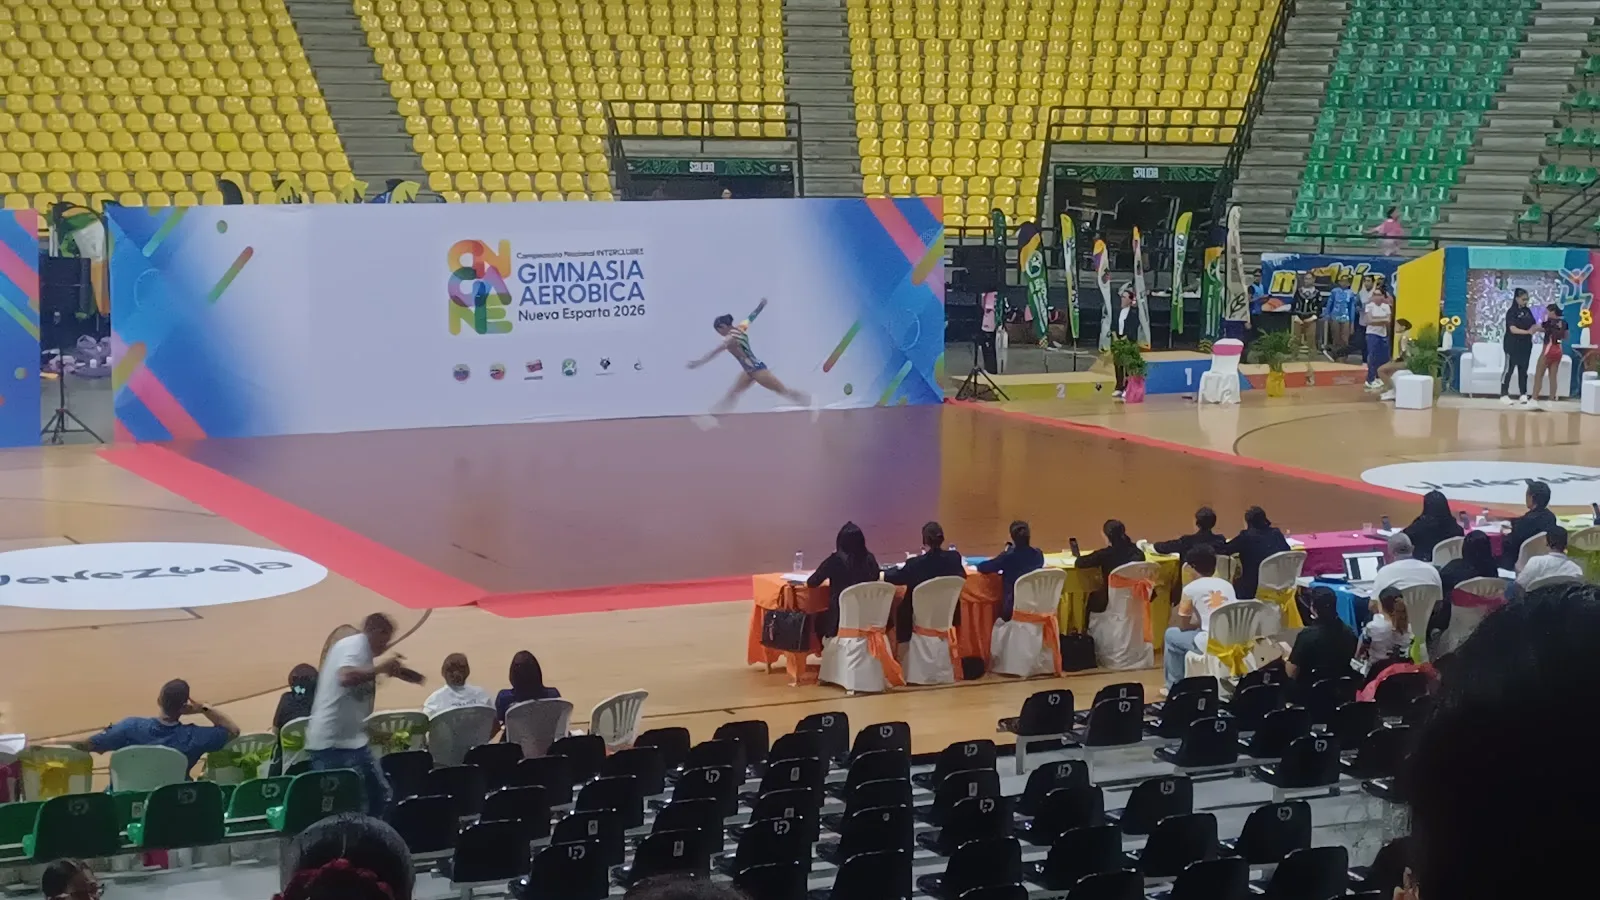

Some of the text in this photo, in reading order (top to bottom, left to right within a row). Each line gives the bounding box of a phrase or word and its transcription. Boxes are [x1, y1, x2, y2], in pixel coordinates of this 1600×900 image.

[517, 260, 644, 284] GIMNASIA
[518, 304, 645, 321] Nueva Esparta 2026
[1184, 367, 1192, 386] 1
[1056, 383, 1066, 399] 2
